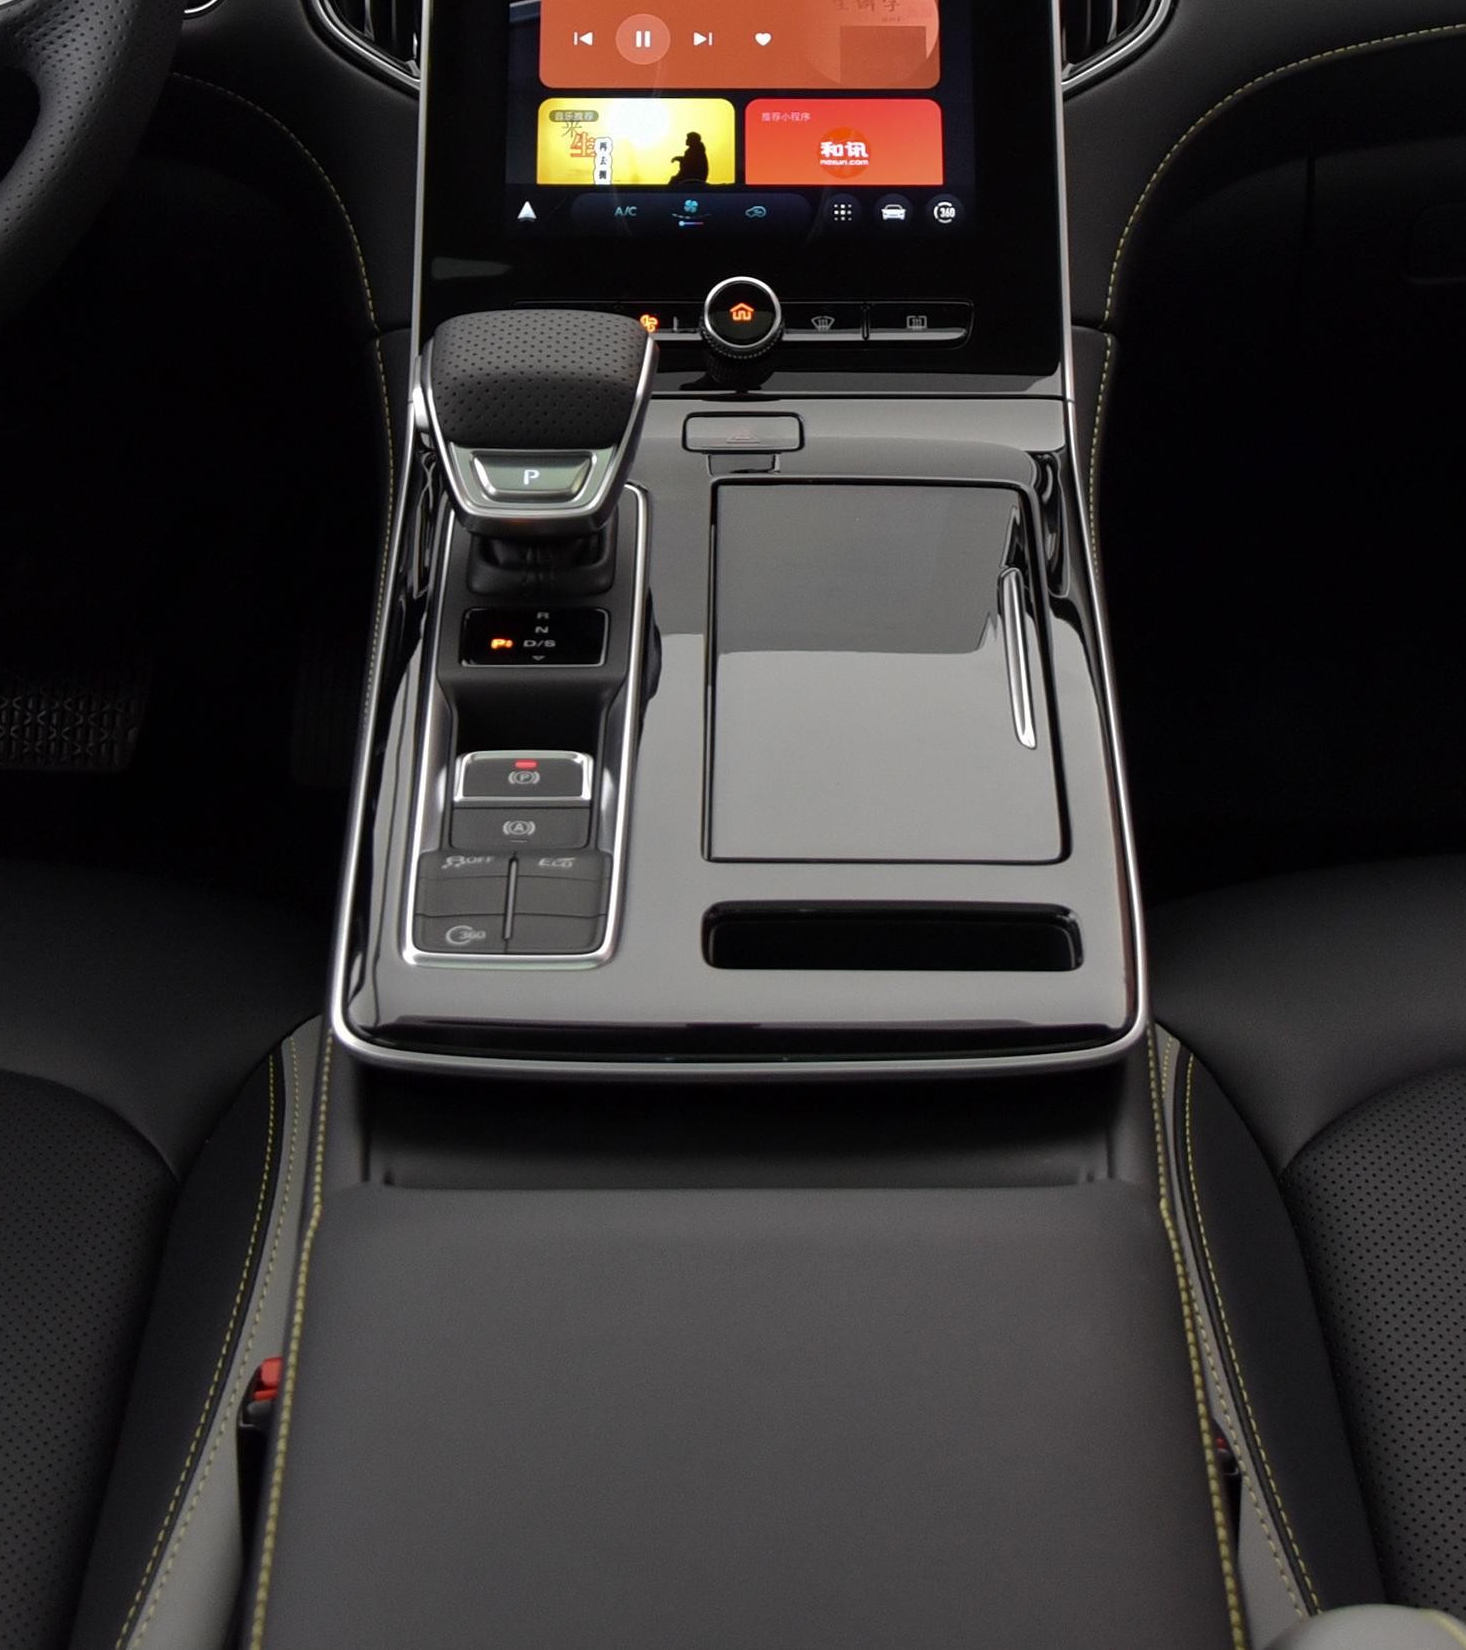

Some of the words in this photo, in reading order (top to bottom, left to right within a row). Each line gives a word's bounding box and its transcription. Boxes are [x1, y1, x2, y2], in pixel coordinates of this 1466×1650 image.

[761, 112, 811, 122] 推荐小程序
[820, 141, 869, 158] 和讯
[614, 206, 637, 216] A/C
[939, 207, 956, 218] 360
[523, 468, 541, 485] P
[535, 626, 549, 634] N
[523, 639, 556, 648] D/S
[466, 856, 495, 864] OFF
[459, 930, 486, 940] 360
